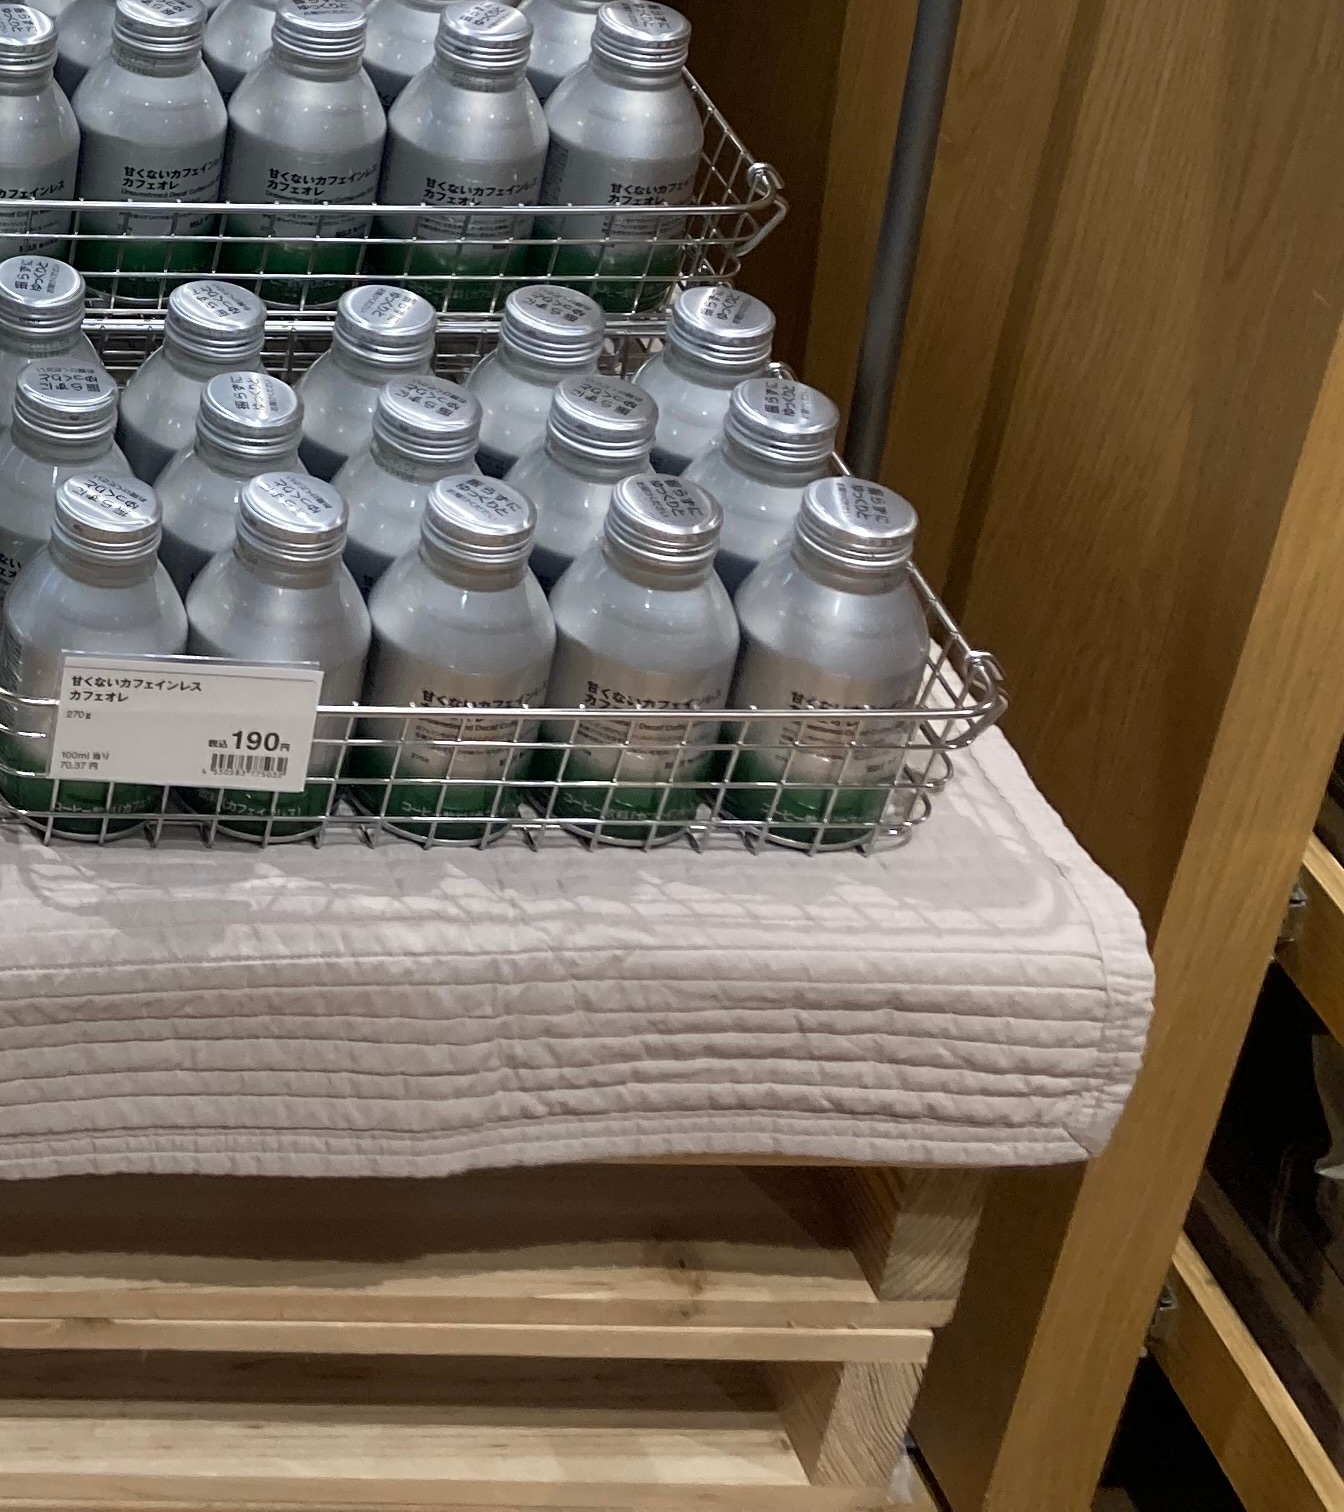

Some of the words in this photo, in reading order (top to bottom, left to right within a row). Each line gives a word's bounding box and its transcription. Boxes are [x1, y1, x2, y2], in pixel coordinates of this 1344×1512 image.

[122, 178, 180, 190] カフェオレ
[267, 180, 325, 196] カフェオレ
[72, 676, 202, 691] 甘くないカフェインレス
[70, 691, 129, 702] カフェオレ
